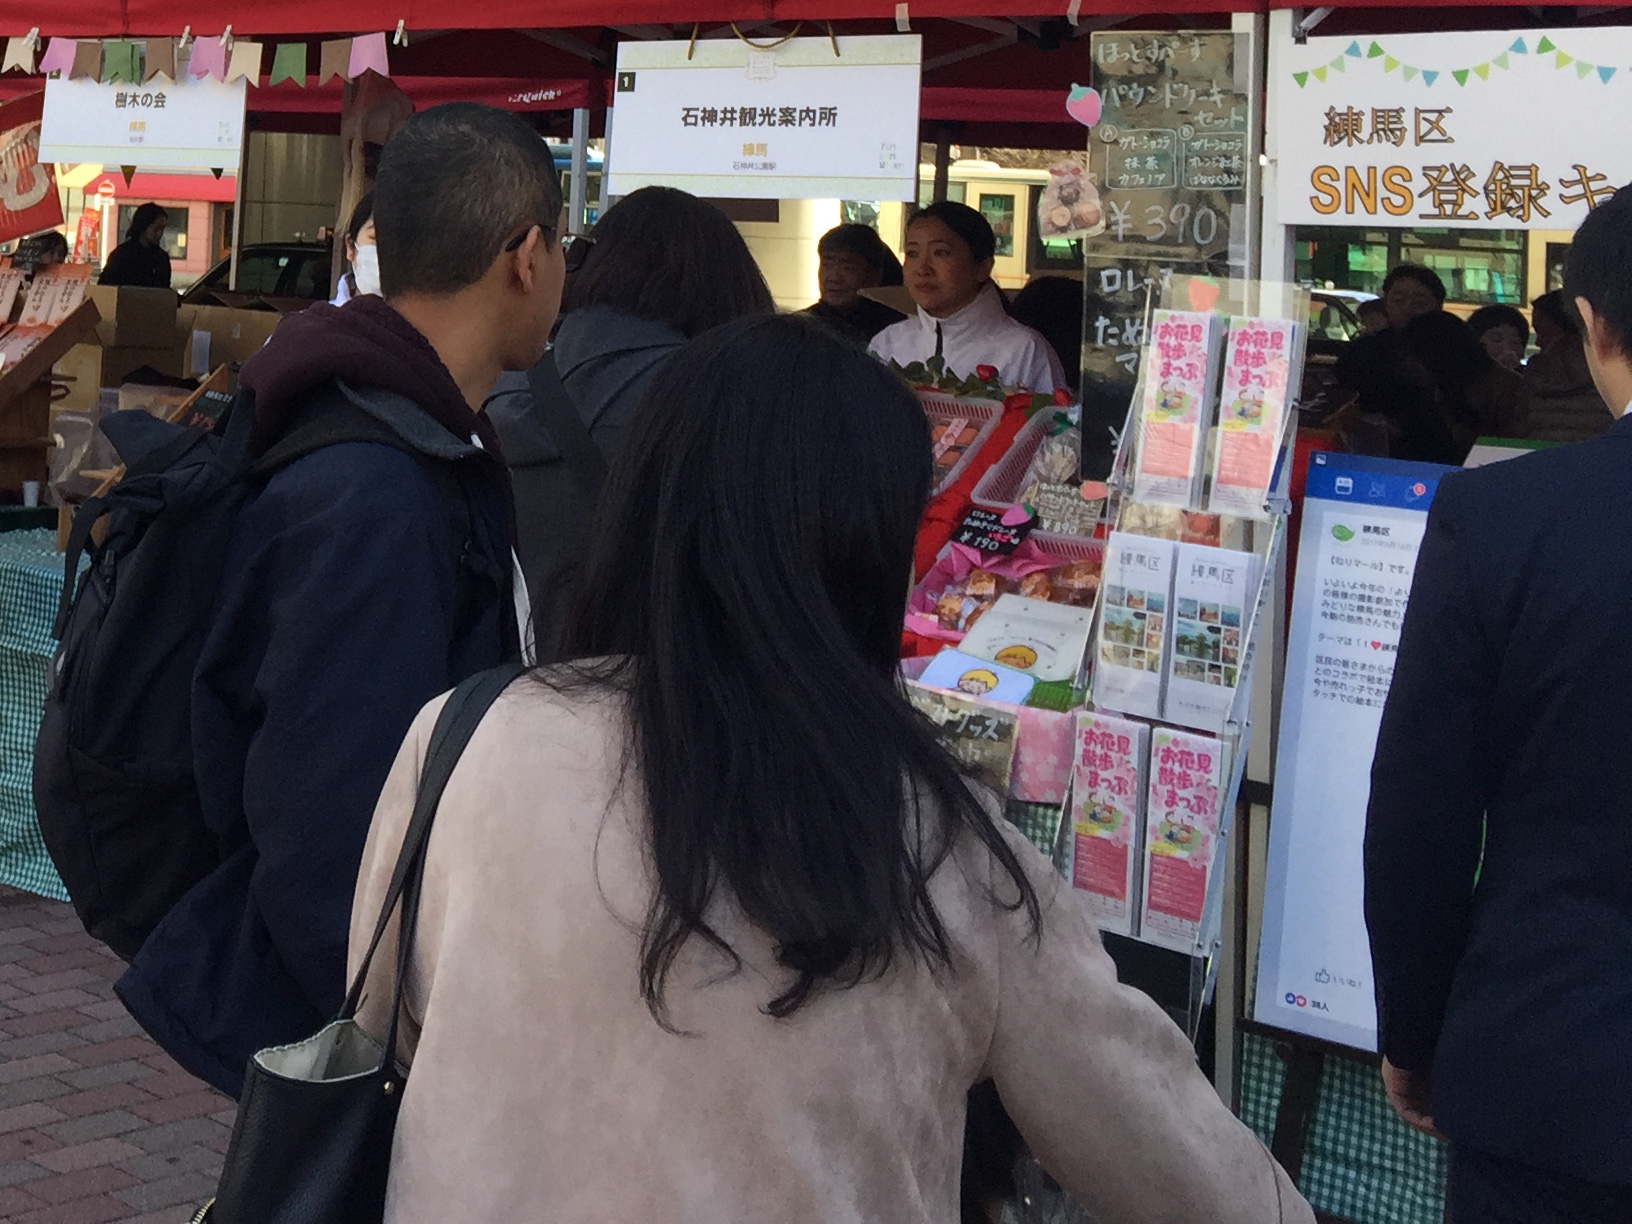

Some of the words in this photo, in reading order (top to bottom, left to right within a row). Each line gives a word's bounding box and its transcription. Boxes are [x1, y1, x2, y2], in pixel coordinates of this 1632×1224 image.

[115, 91, 167, 109] 樹木の会
[681, 106, 838, 127] 石神井観光案内所
[1194, 107, 1245, 129] セット
[1323, 105, 1455, 147] 練馬区
[742, 142, 768, 157] 練馬
[1124, 156, 1159, 169] 抹茶
[1159, 323, 1203, 343] お花見
[1236, 329, 1284, 350] お花見
[1158, 342, 1186, 361] 散歩
[1233, 349, 1266, 368] 散歩
[1160, 362, 1199, 382] まっぷ
[1238, 368, 1279, 388] まっぷ
[1363, 525, 1390, 537] 練馬区
[1083, 728, 1131, 757] お花見
[1081, 749, 1113, 771] 散歩
[1160, 747, 1212, 775] お花見
[1088, 770, 1128, 796] まっぷ
[1158, 766, 1193, 790] 散歩
[1164, 790, 1209, 815] まっぷ
